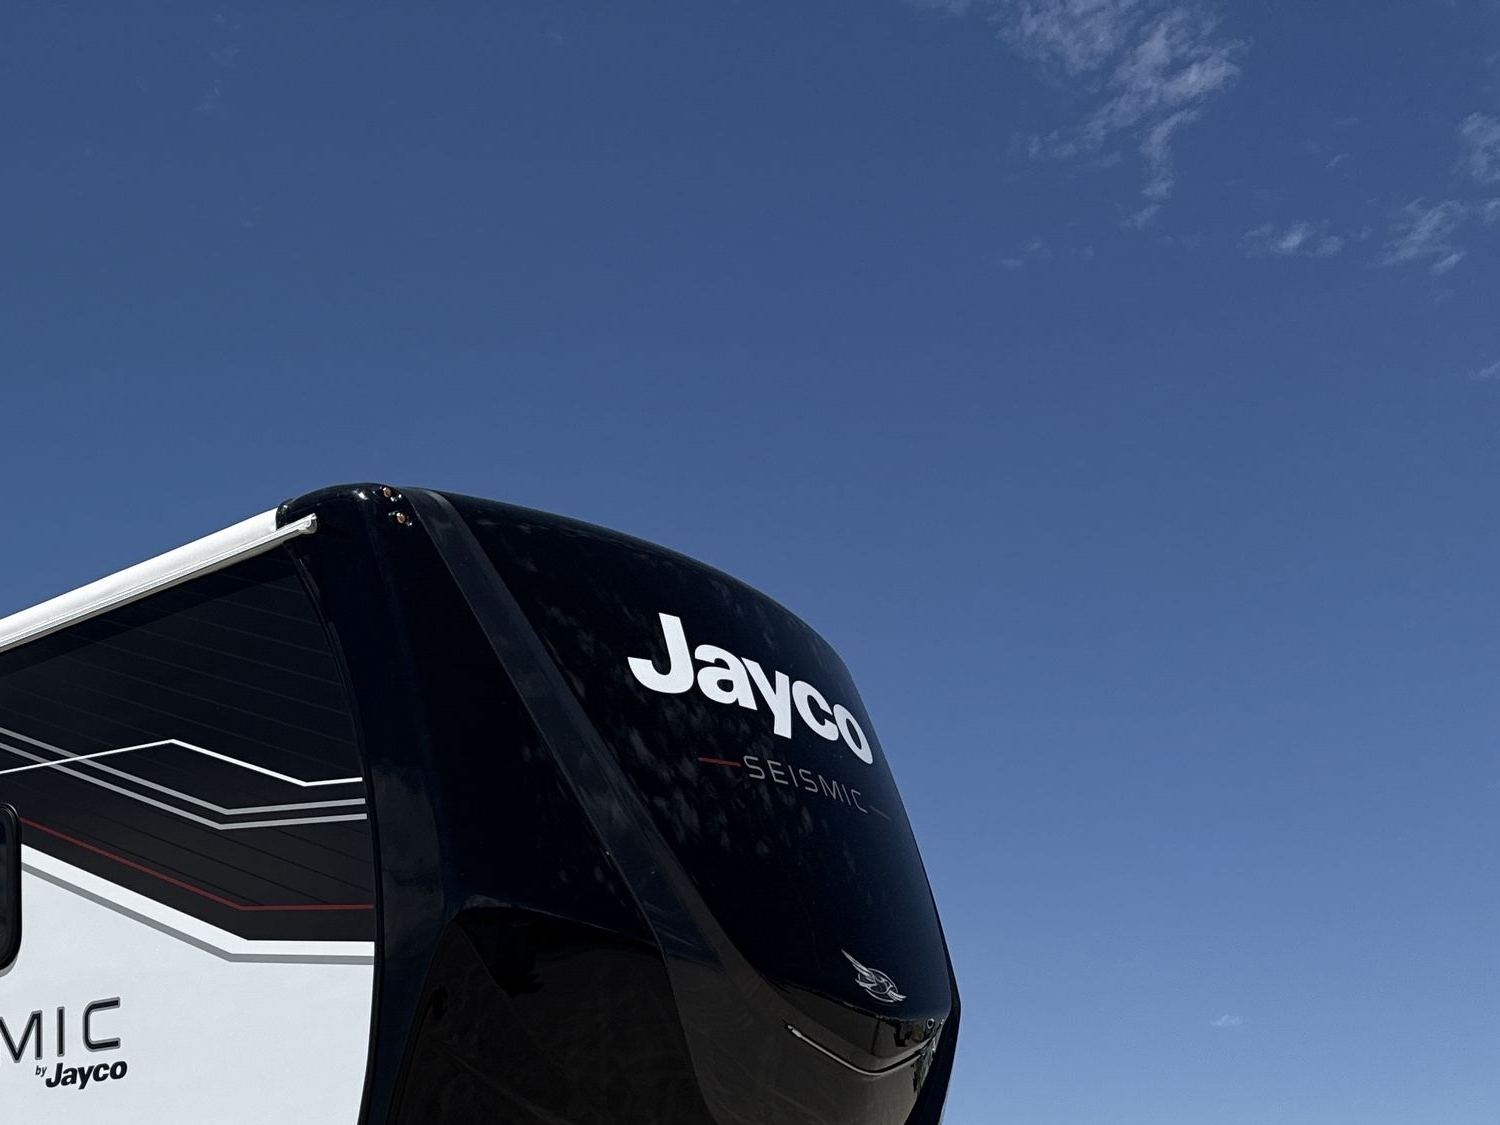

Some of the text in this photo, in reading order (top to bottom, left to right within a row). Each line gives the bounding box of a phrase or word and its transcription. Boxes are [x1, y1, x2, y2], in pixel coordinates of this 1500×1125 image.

[627, 612, 873, 764] Jayco
[743, 755, 868, 813] SEISMIC
[35, 1060, 128, 1090] by Jayco
